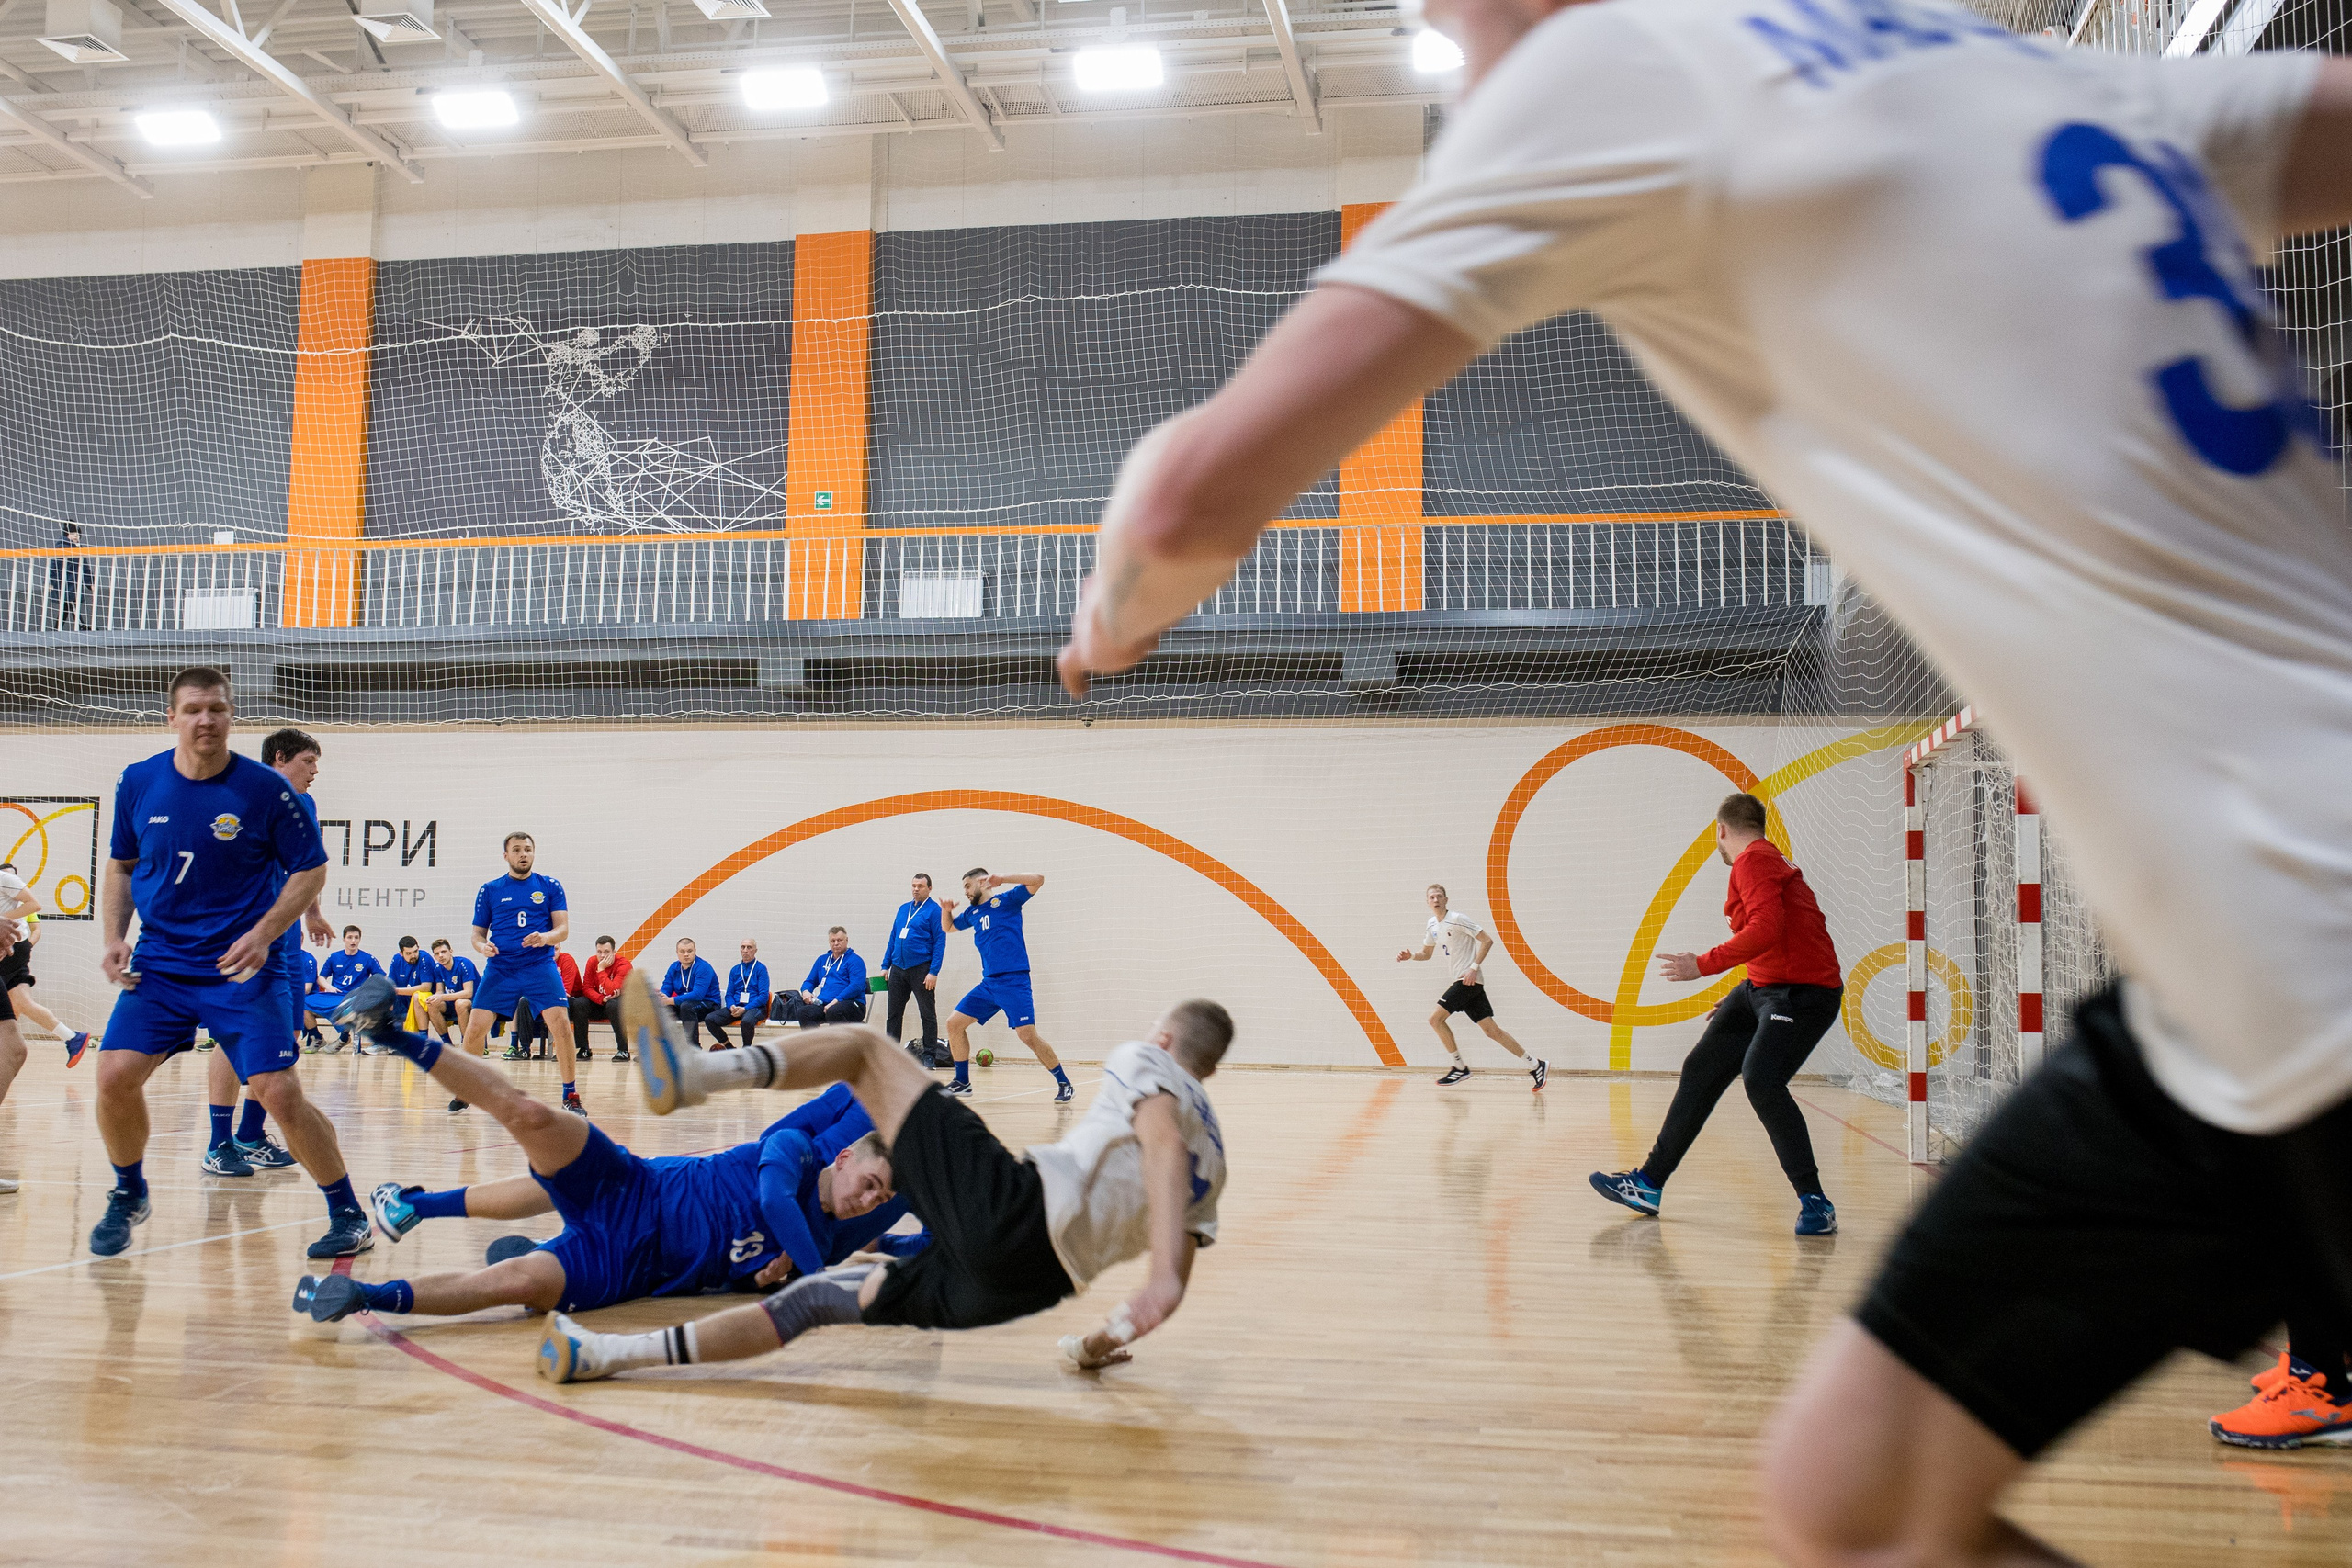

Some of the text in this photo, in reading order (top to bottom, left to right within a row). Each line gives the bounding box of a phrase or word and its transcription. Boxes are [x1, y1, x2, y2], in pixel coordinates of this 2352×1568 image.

[174, 851, 195, 885] 7
[337, 887, 426, 910] ЦЕНТР
[517, 910, 527, 928] 6
[979, 915, 990, 931] 10
[342, 975, 353, 986] 21
[729, 1231, 764, 1263] 13
